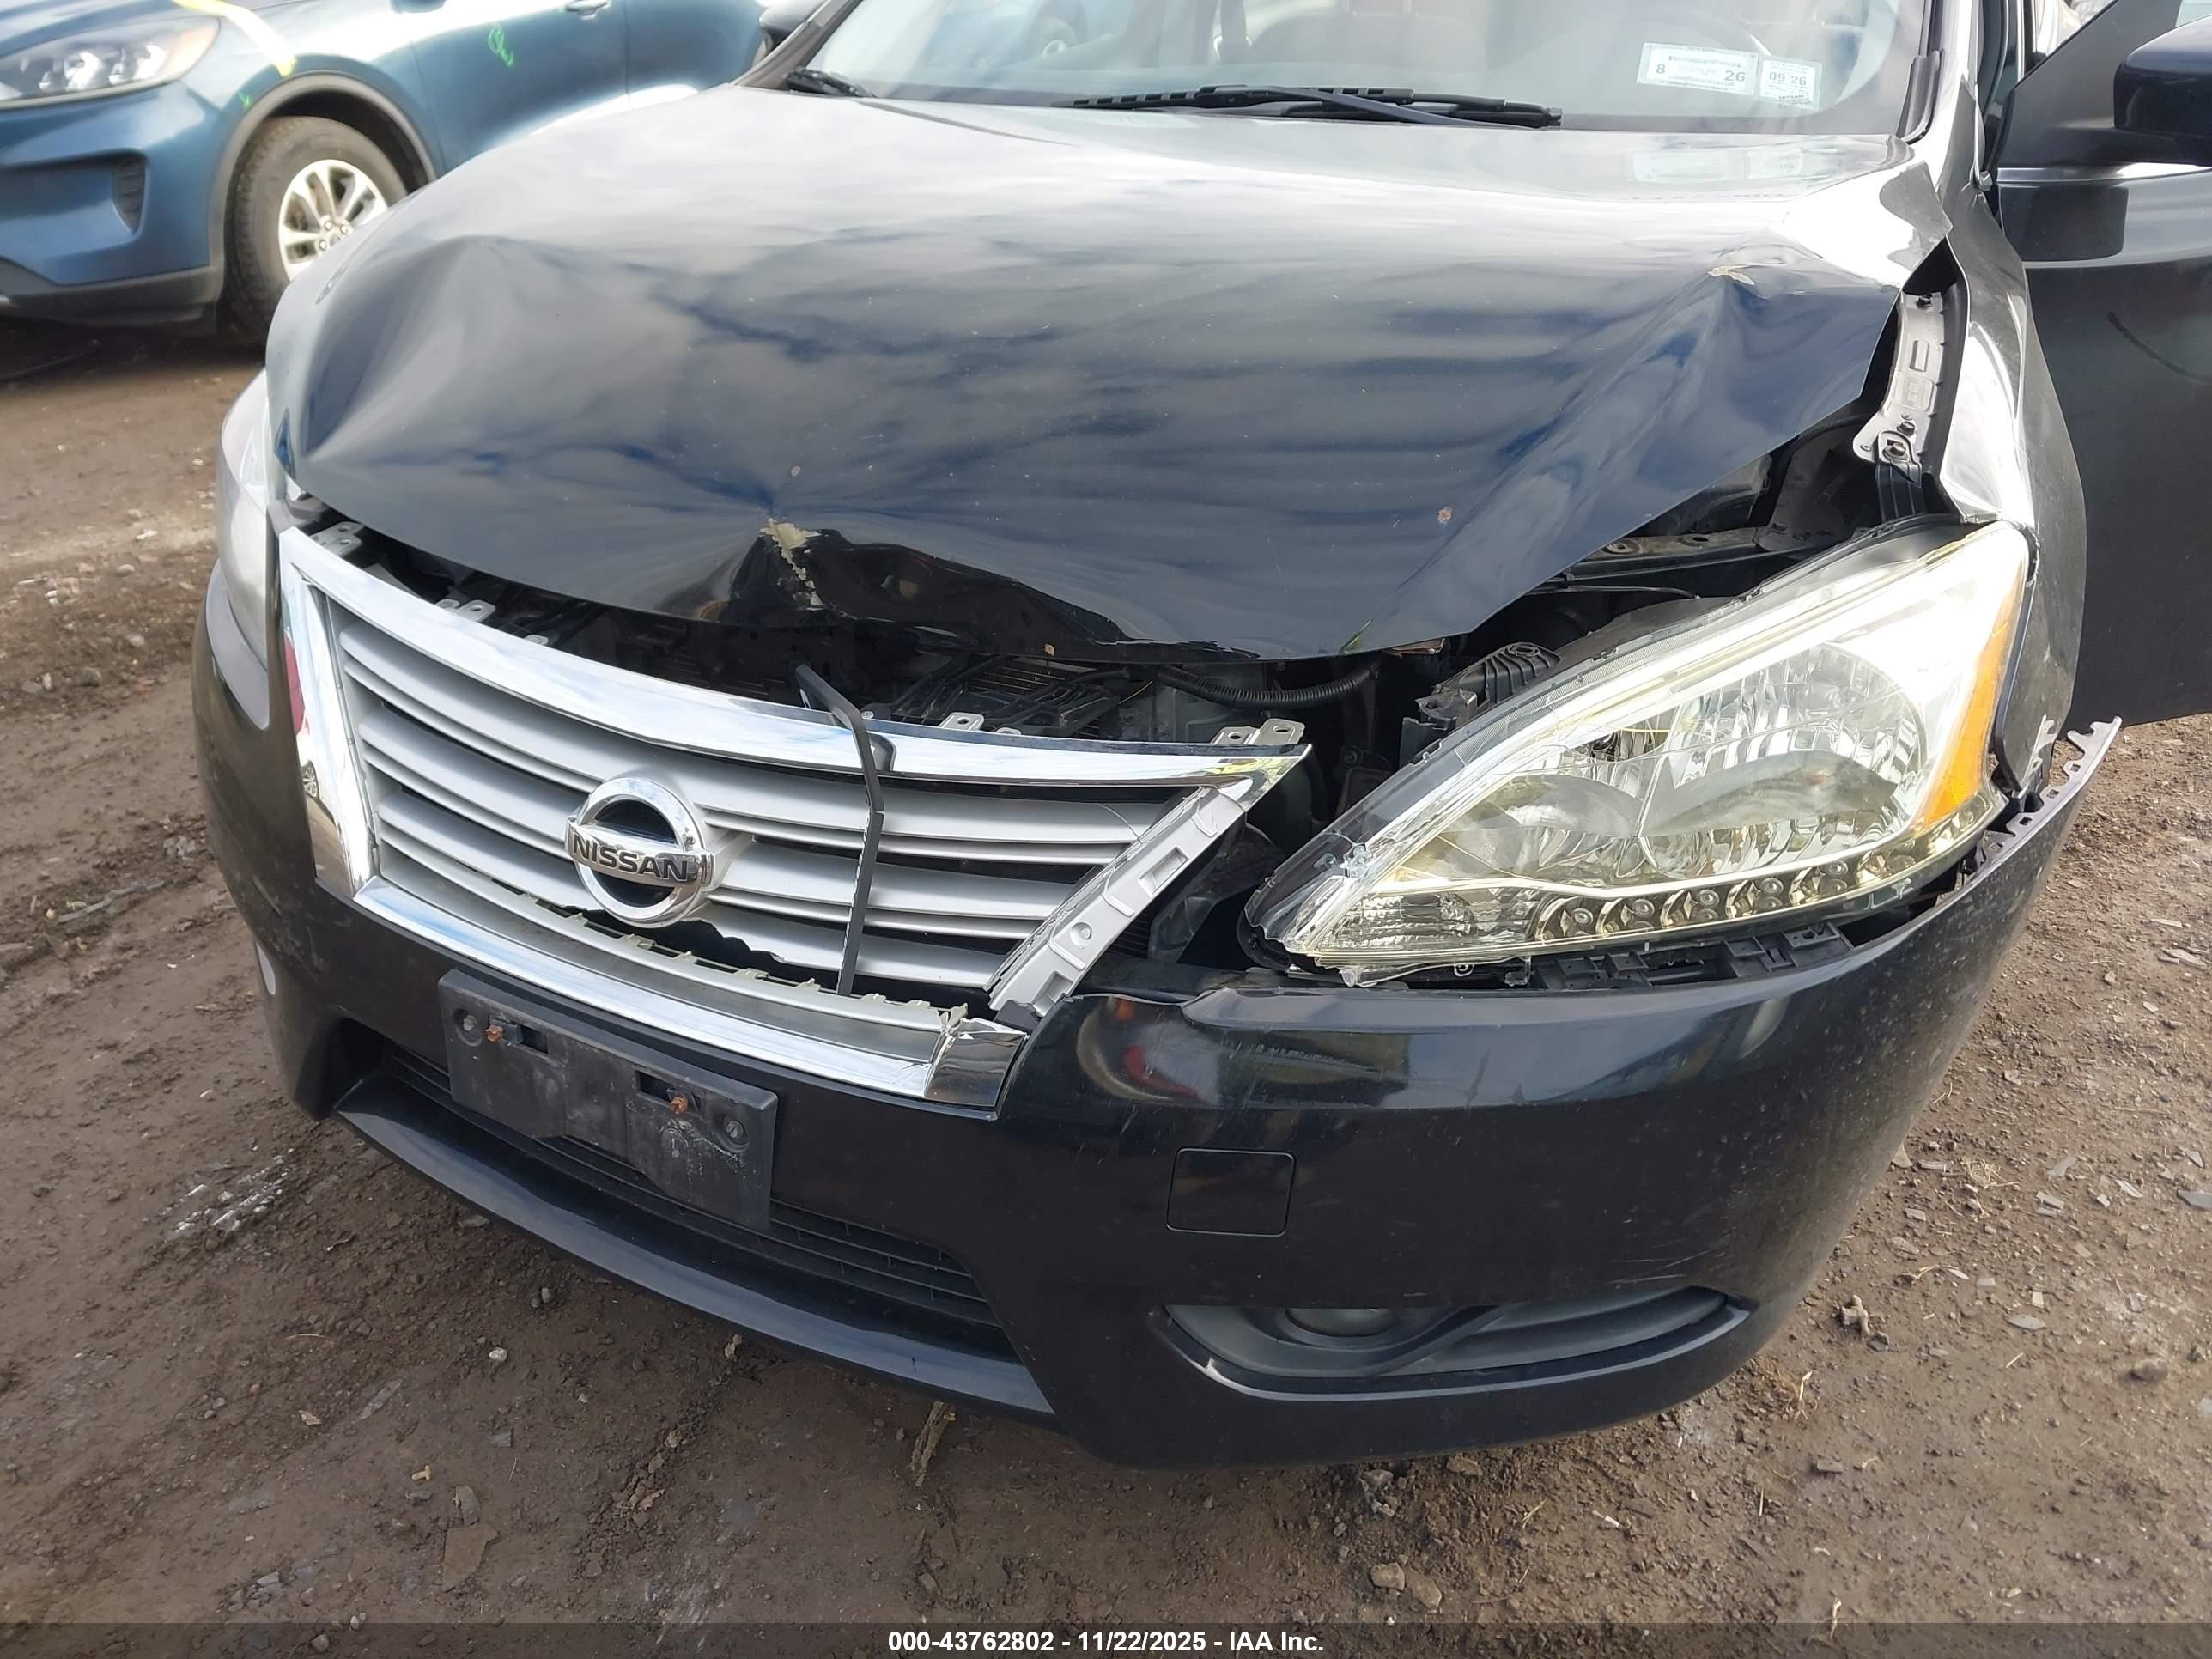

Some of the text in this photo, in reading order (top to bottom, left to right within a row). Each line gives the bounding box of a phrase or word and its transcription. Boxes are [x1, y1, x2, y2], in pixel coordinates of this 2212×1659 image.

[1656, 64, 1666, 76] 8
[1723, 70, 1746, 82] 26
[1769, 71, 1807, 86] 09 26
[573, 834, 688, 880] NISSAN
